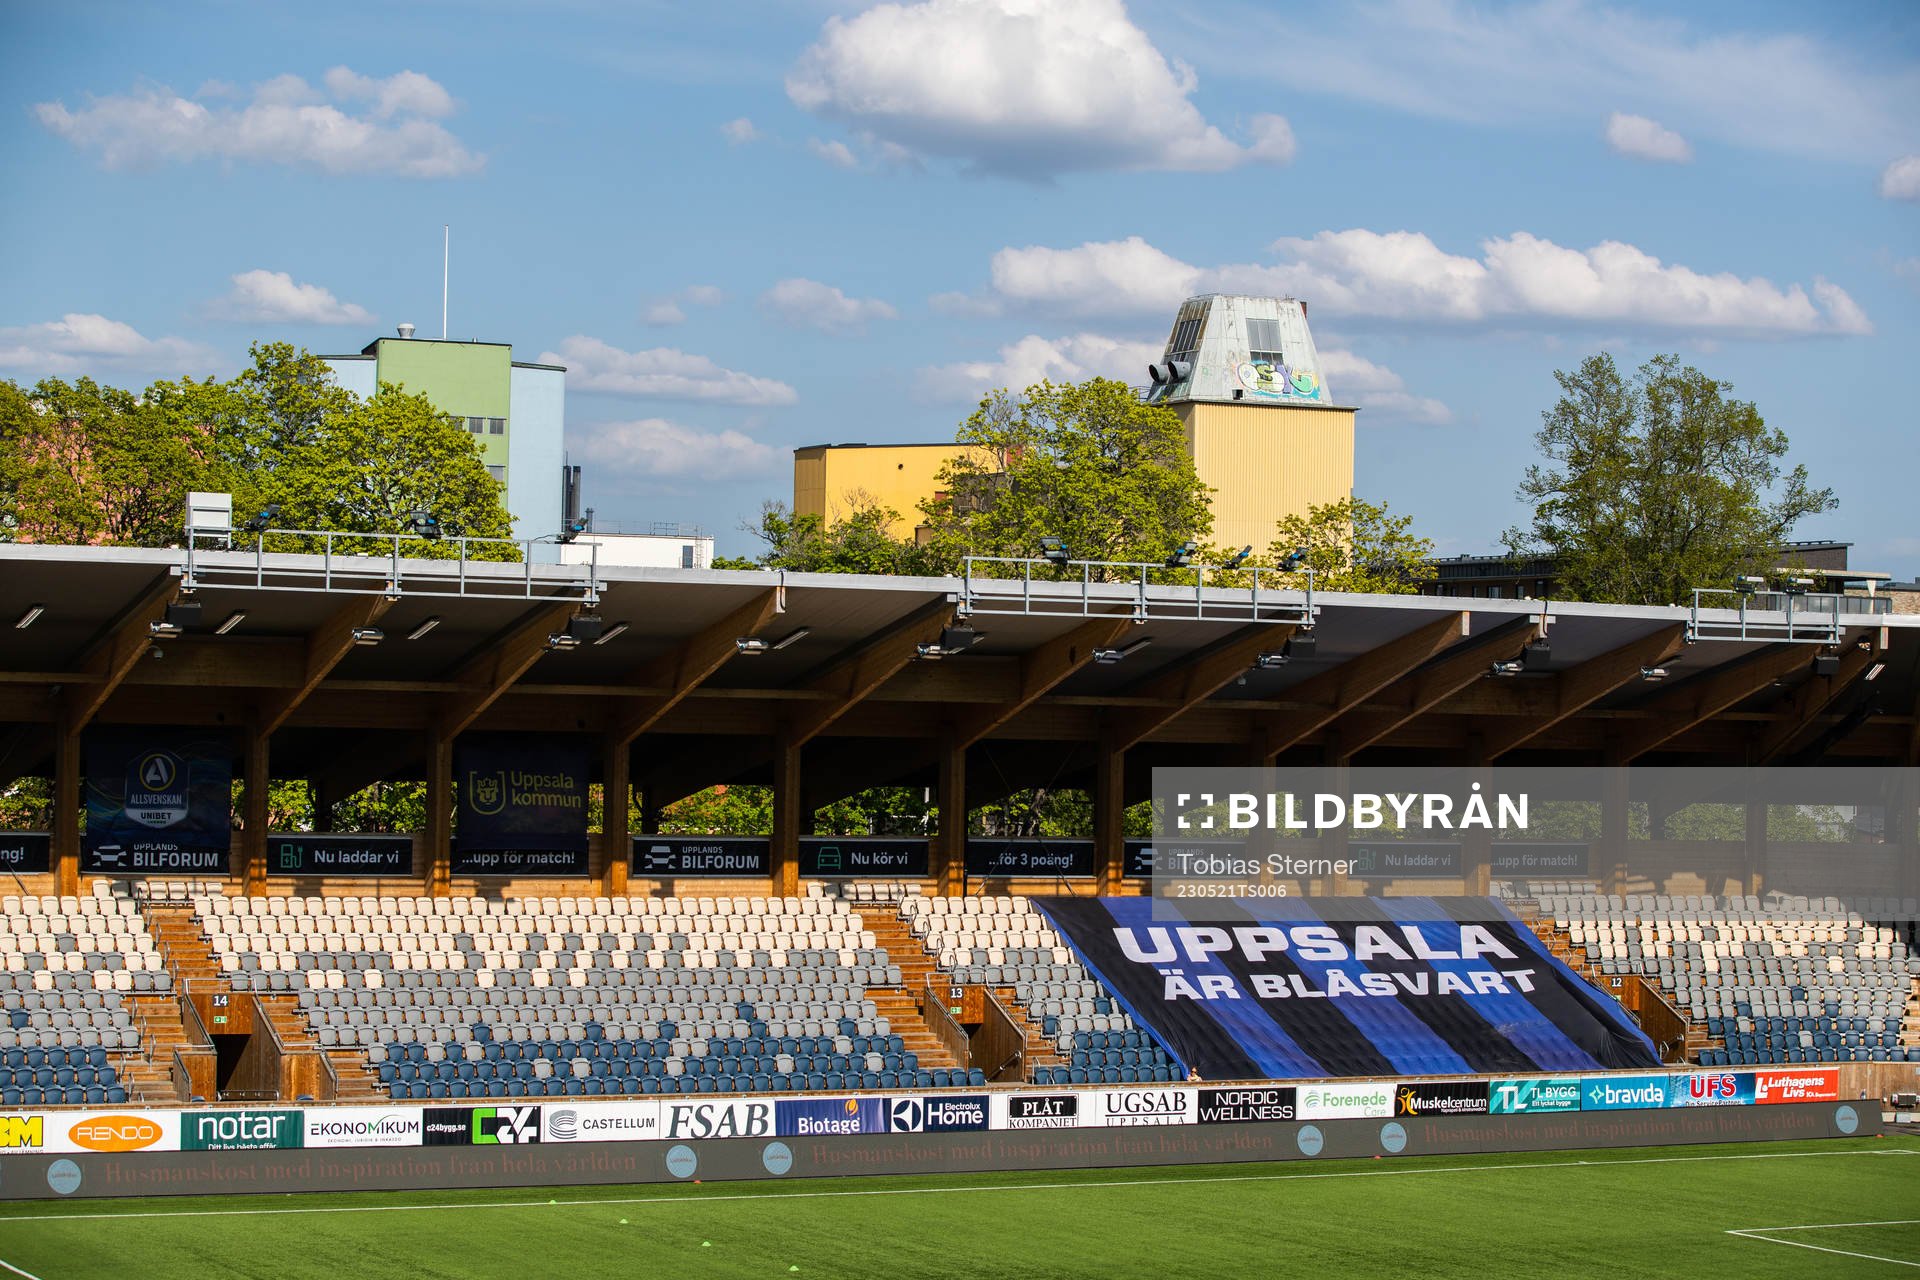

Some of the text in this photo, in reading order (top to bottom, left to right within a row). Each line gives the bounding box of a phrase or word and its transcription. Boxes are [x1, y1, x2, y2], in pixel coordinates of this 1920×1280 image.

[510, 770, 575, 790] Uppsala
[130, 793, 183, 806] ALLSVENSKAN
[511, 789, 582, 808] kommun
[141, 812, 172, 821] UNIBET
[133, 843, 179, 851] UPPLANDS
[681, 846, 724, 854] UPPLANDS
[133, 852, 219, 868] BILFORUM
[313, 849, 399, 865] Nu laddar vi
[503, 851, 525, 864] för
[527, 851, 576, 864] match!
[681, 855, 760, 869] BILFORUM
[851, 851, 909, 865] Nu kör vi
[1020, 852, 1029, 866] 3
[1031, 852, 1074, 870] poäng!
[1384, 853, 1452, 867] Nu laddar vi
[1515, 854, 1538, 867] för
[1540, 854, 1578, 867] match!
[1113, 924, 1519, 964] UPPSALA
[1159, 967, 1537, 1000] ÄR BLÅSVART
[1611, 977, 1623, 988] 12
[213, 995, 229, 1007] 14
[951, 988, 963, 999] 13
[1690, 1073, 1737, 1099] UFS
[1768, 1076, 1825, 1089] Luthagens
[1215, 1091, 1279, 1106] NORDIC
[1322, 1091, 1387, 1107] Forenede
[1530, 1087, 1577, 1099] TL BYGG
[1605, 1083, 1664, 1104] bravida
[1783, 1087, 1805, 1098] Livs
[944, 1101, 981, 1111] Electrolux
[1022, 1097, 1064, 1116] PLÅT
[1105, 1091, 1187, 1113] UGSAB
[1410, 1095, 1487, 1110] Muskelcentrum
[928, 1103, 984, 1126] Home
[1200, 1105, 1294, 1121] WELLNESS
[1364, 1106, 1386, 1118] Care
[198, 1111, 286, 1140] notar
[310, 1119, 419, 1136] EKONOMIKUM
[426, 1123, 466, 1133] c24bygg.se
[582, 1117, 655, 1130] CASTELLUM
[665, 1103, 769, 1139] FSAB
[798, 1115, 861, 1135] Biotage
[1009, 1117, 1077, 1129] KOMPANIET
[1106, 1116, 1185, 1128] UPPSALA
[76, 1125, 154, 1141] RENDO
[812, 1143, 945, 1165] Husmanskost
[951, 1139, 993, 1160] med
[104, 1160, 258, 1185] Husmanskost
[264, 1157, 312, 1181] med
[319, 1155, 442, 1182] inspiration
[501, 1151, 548, 1174] hela
